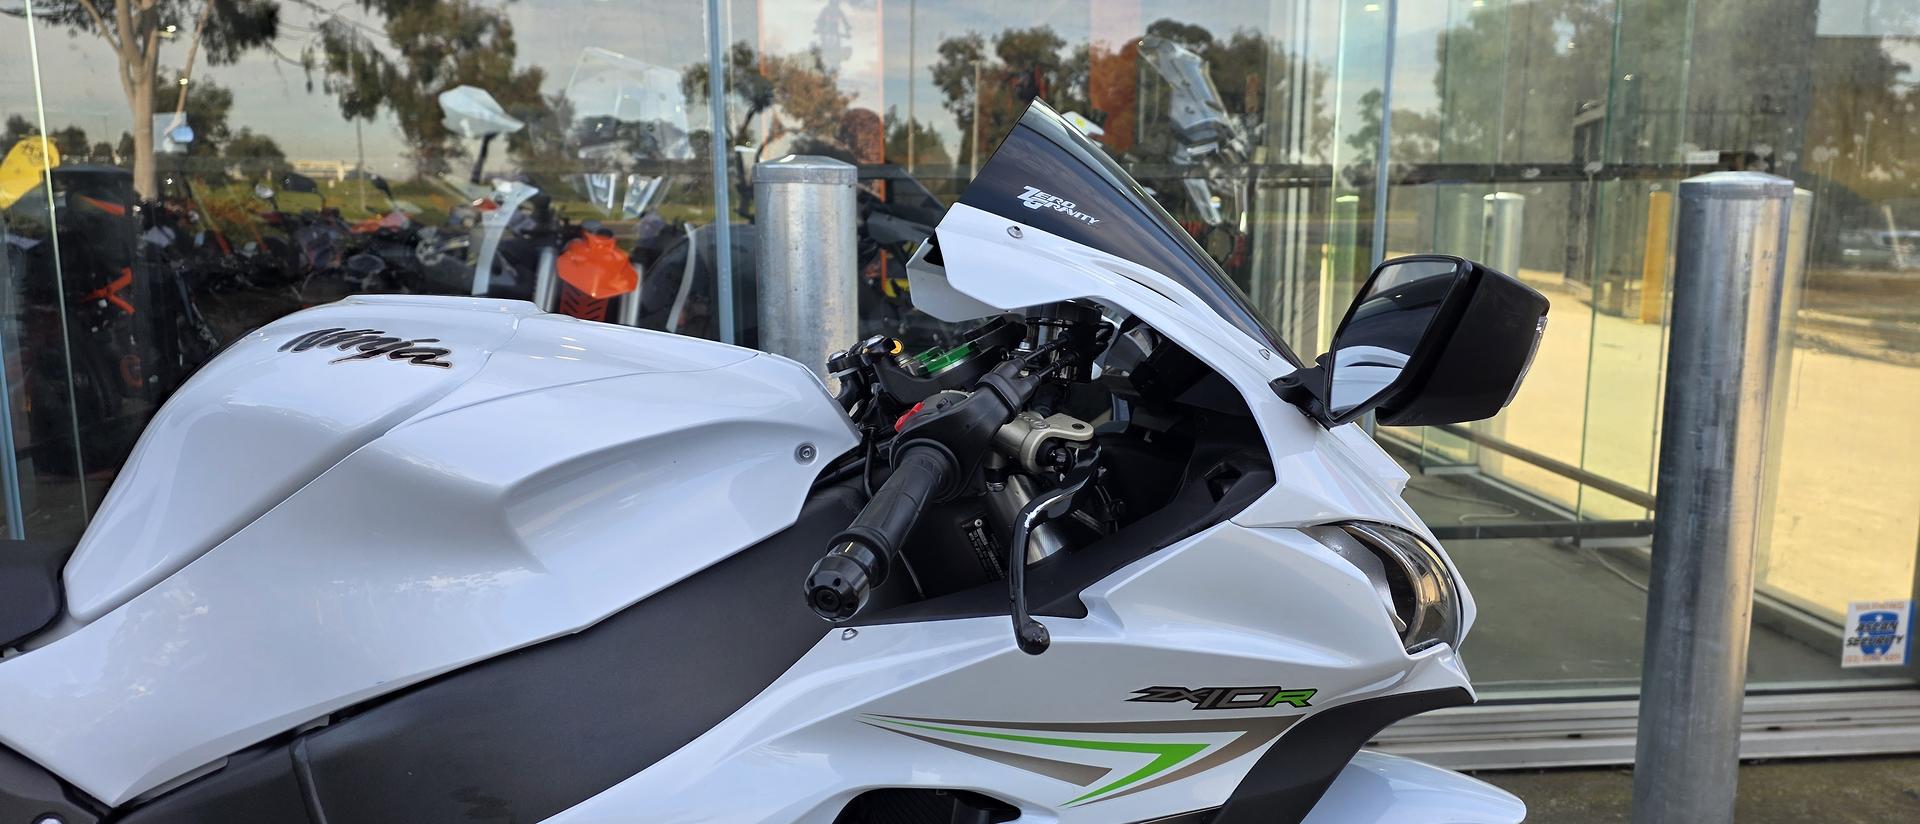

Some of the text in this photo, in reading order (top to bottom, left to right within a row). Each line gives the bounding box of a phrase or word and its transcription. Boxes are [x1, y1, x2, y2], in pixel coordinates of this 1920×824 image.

[1017, 185, 1077, 209] ZERO
[1023, 200, 1100, 225] GRAVITY
[277, 327, 453, 369] Ninja
[1846, 635, 1905, 648] SECURITY
